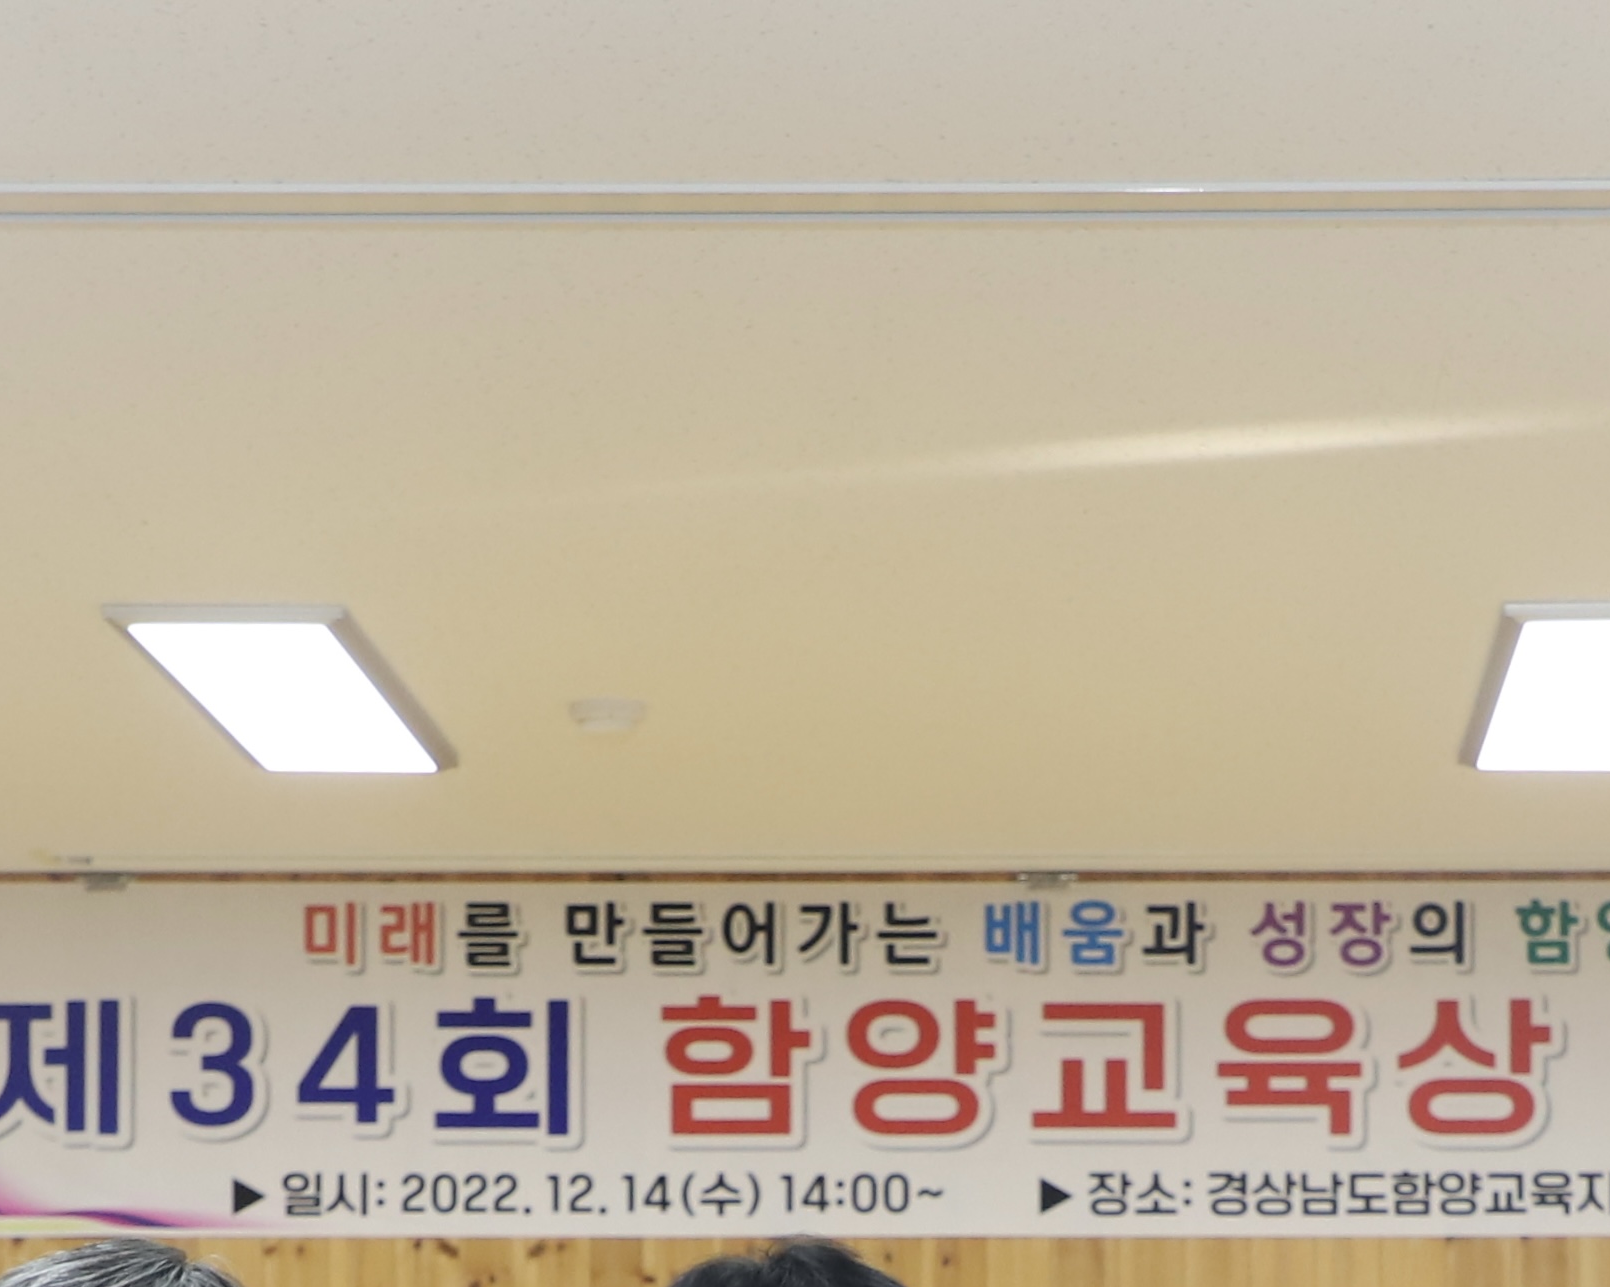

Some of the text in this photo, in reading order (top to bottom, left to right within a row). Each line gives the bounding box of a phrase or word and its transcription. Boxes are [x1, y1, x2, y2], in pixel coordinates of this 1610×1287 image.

[304, 901, 519, 968] 미래를
[565, 901, 938, 967] 만들어가는
[984, 900, 1205, 967] 배움과
[1250, 900, 1466, 967] 성장의
[660, 995, 1552, 1136] 함양교육상
[281, 1172, 385, 1217] 일시:
[1088, 1171, 1191, 1217] 장소:
